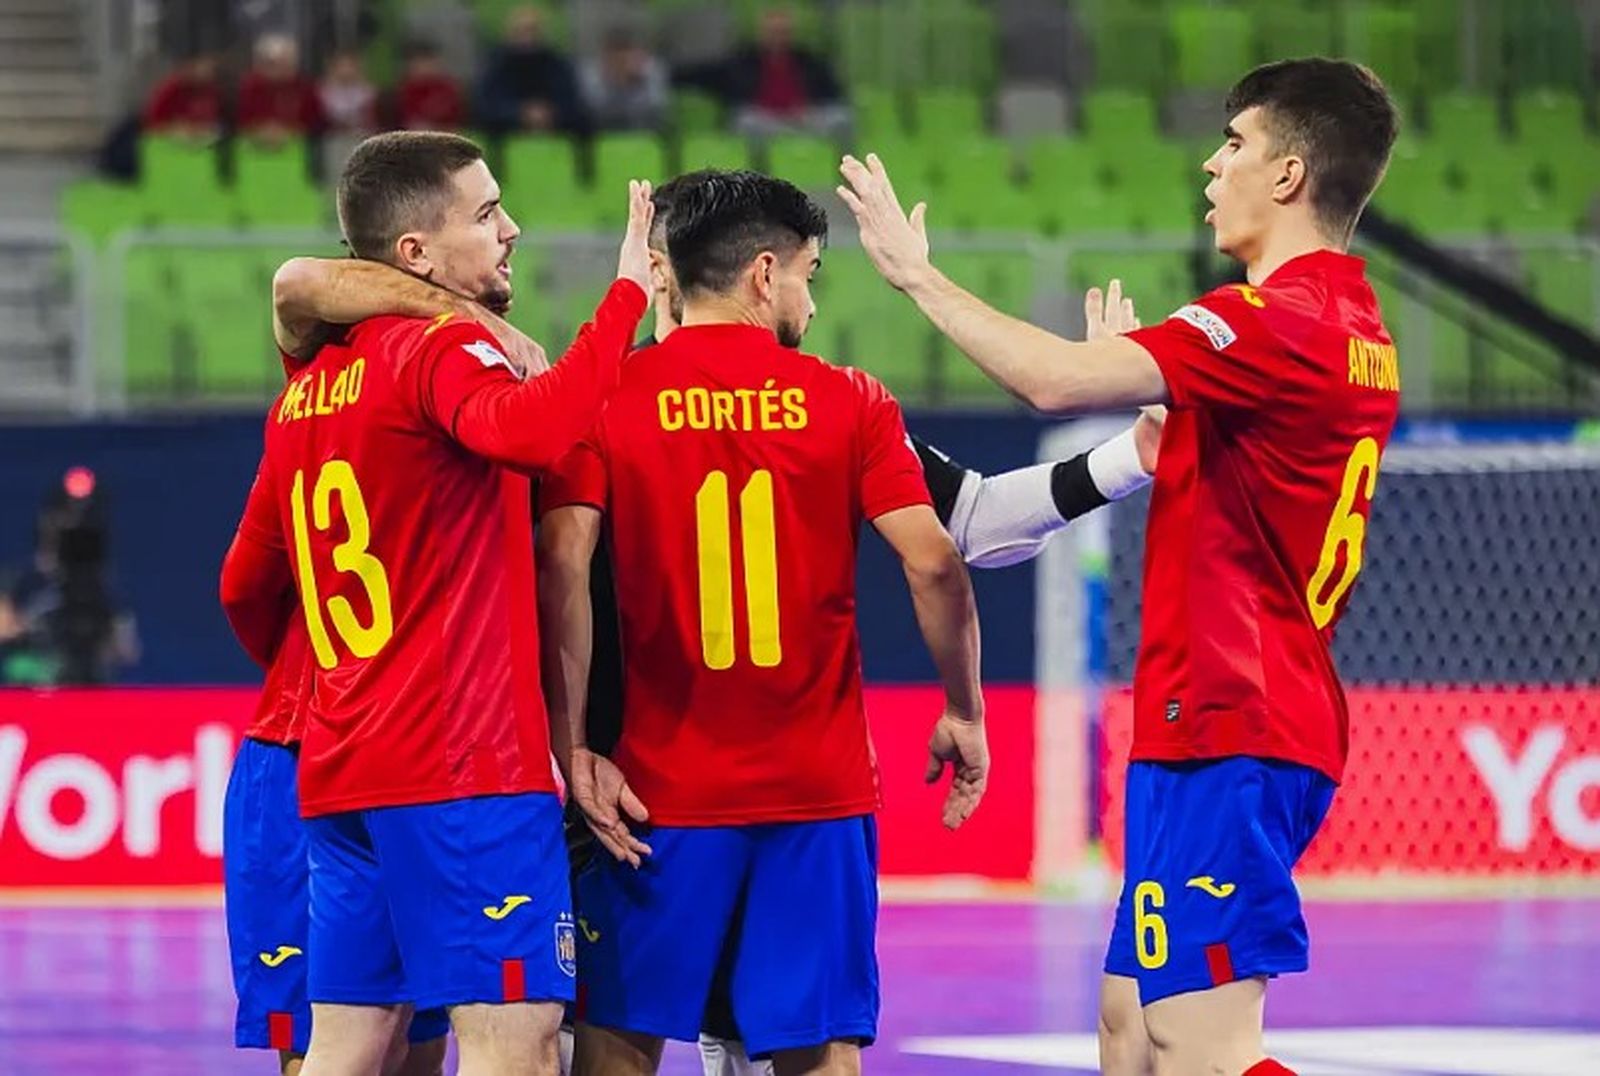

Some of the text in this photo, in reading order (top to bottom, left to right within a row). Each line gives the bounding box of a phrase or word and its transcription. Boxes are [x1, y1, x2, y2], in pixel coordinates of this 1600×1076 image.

[656, 378, 809, 432] CORTÉS
[290, 459, 394, 671] 13
[695, 468, 783, 671] 11
[1305, 436, 1379, 631] 6
[0, 723, 234, 861] orl
[1134, 880, 1169, 970] 6
